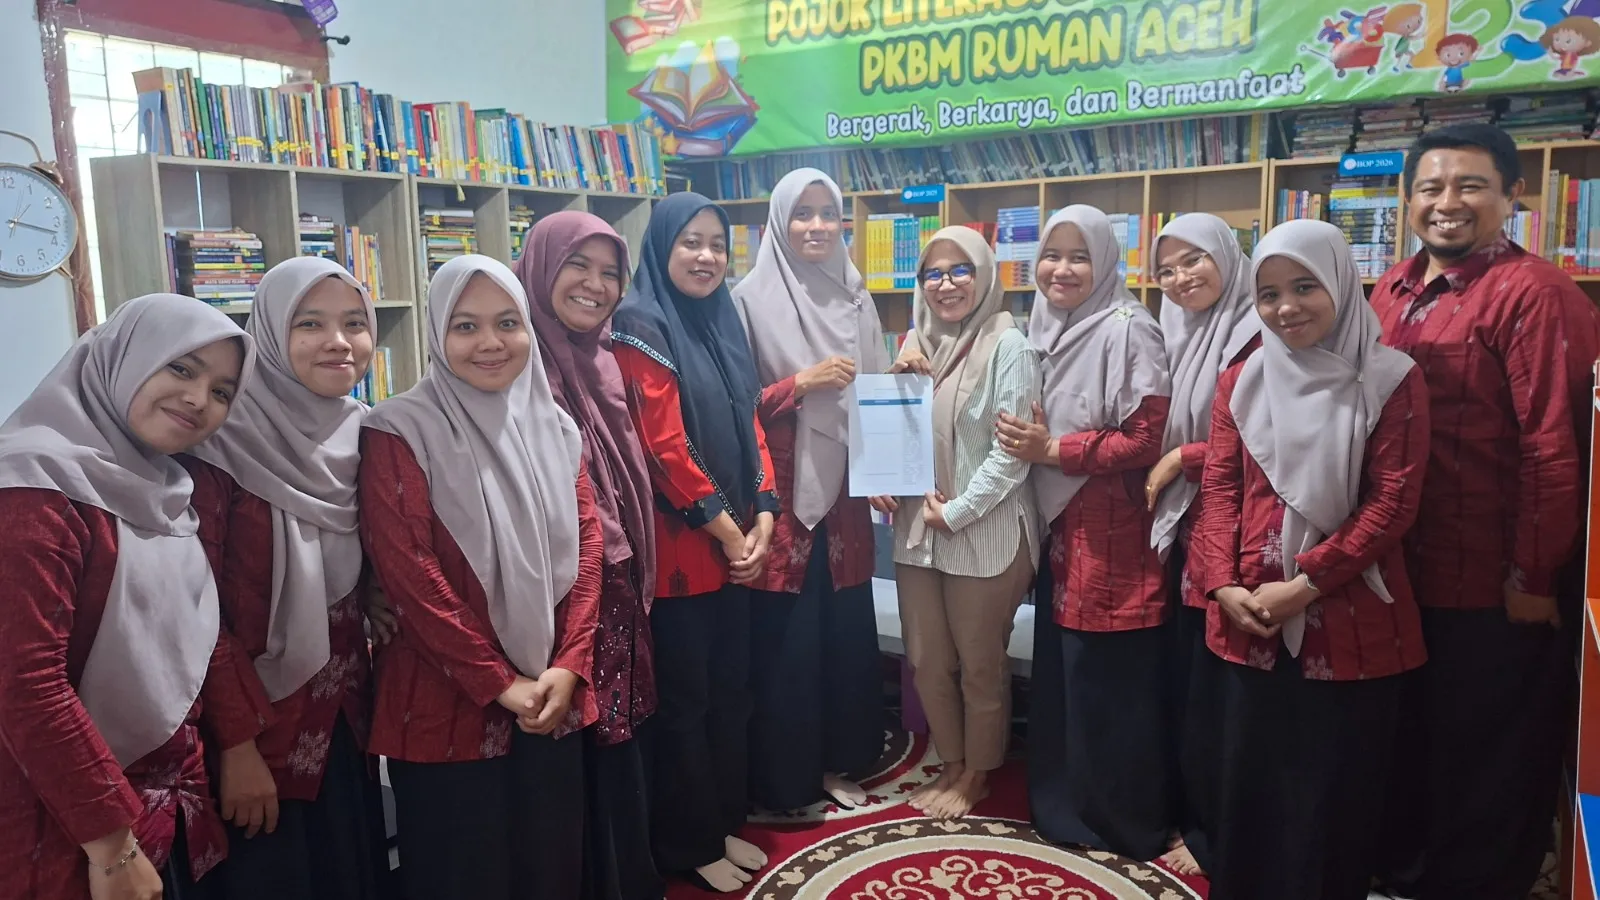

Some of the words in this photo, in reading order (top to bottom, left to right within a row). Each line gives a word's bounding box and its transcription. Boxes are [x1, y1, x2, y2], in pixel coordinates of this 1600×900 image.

[766, 0, 872, 43] POJOK
[881, 0, 1042, 28] LITE
[861, 33, 965, 92] PKBM
[971, 11, 1123, 80] RUMAN
[1134, 0, 1253, 60] ACEH
[826, 104, 932, 141] Bergerak,
[937, 97, 1059, 128] Berkarya,
[1065, 86, 1118, 116] dan
[1126, 64, 1306, 112] Bermanfaat
[2, 176, 15, 189] 12
[27, 183, 33, 195] 1
[44, 196, 53, 209] 2
[53, 215, 61, 228] 3
[50, 234, 58, 247] 4
[16, 254, 26, 267] 6
[37, 248, 46, 261] 5
